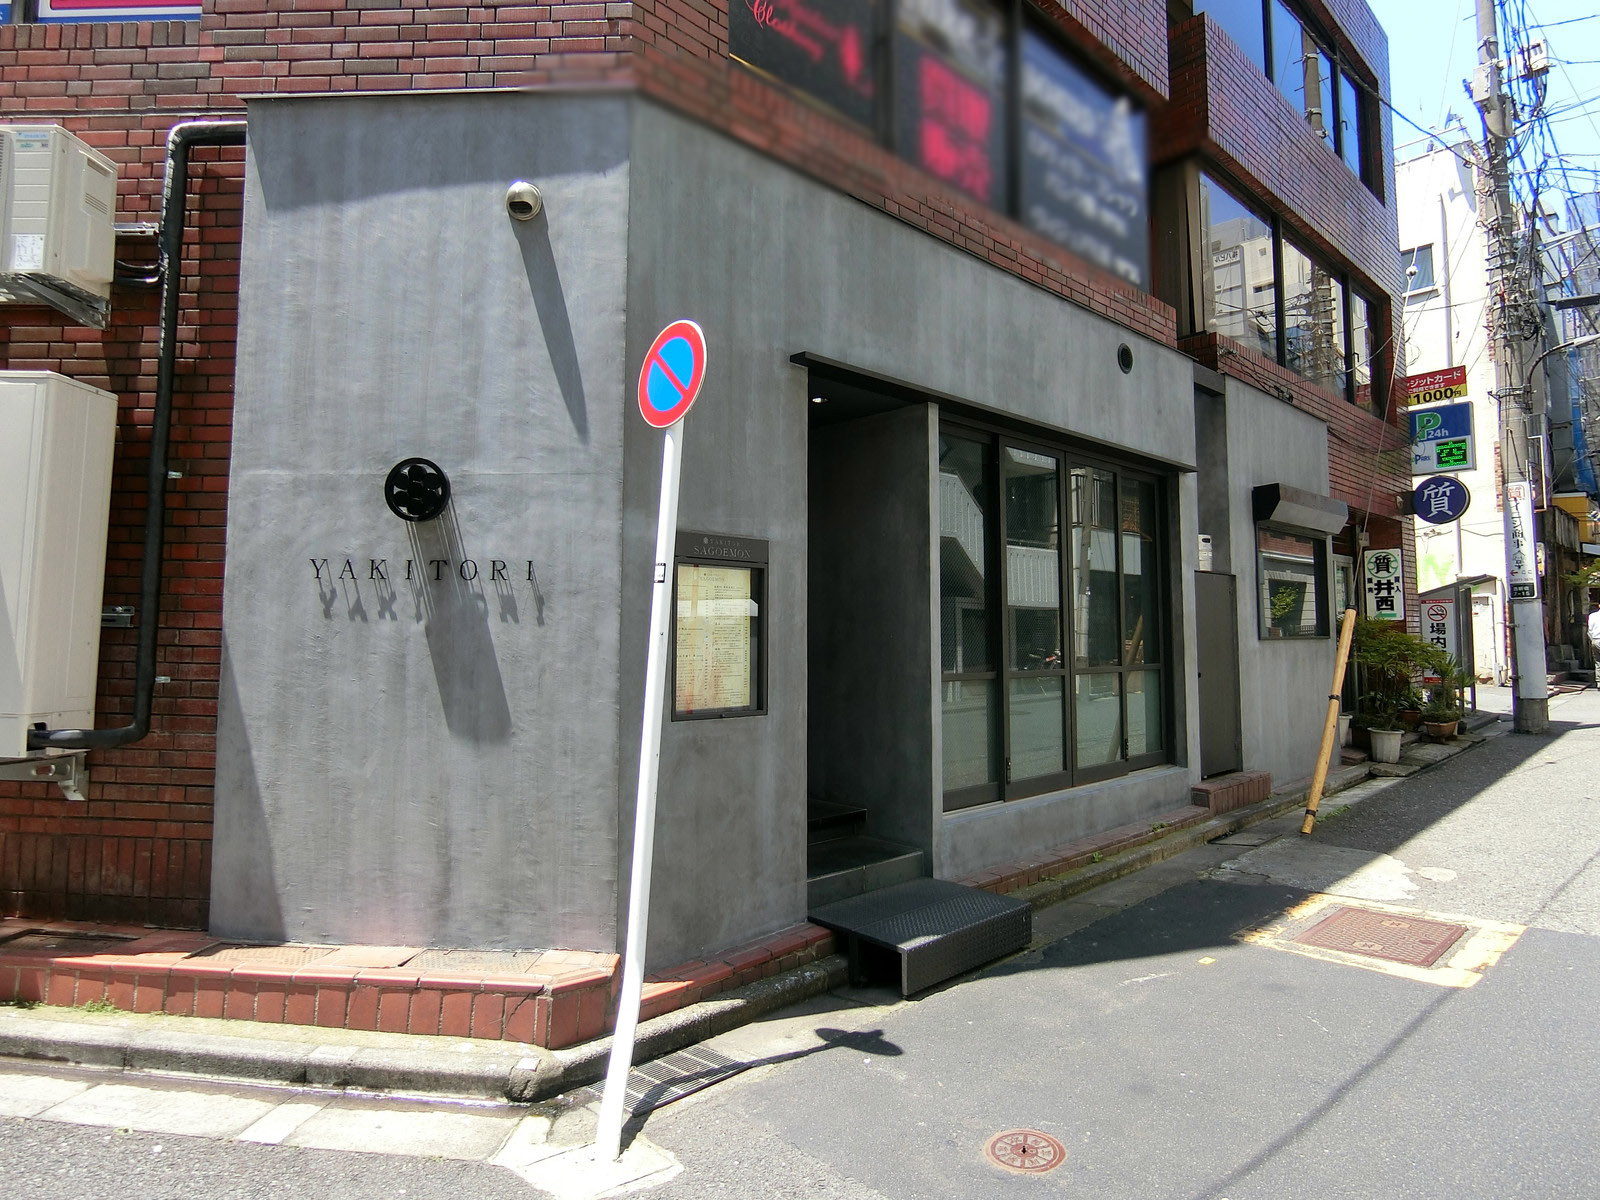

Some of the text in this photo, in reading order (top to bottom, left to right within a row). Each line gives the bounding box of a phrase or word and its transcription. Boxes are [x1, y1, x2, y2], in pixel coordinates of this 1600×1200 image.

[1407, 371, 1461, 387] ジットカード
[1408, 388, 1461, 404] 1000円
[1415, 412, 1441, 440] P
[1428, 429, 1449, 439] 24h
[1422, 482, 1456, 518] 質
[309, 558, 534, 581] YAKITORI
[1374, 554, 1391, 574] 質
[1374, 579, 1395, 612] 井西
